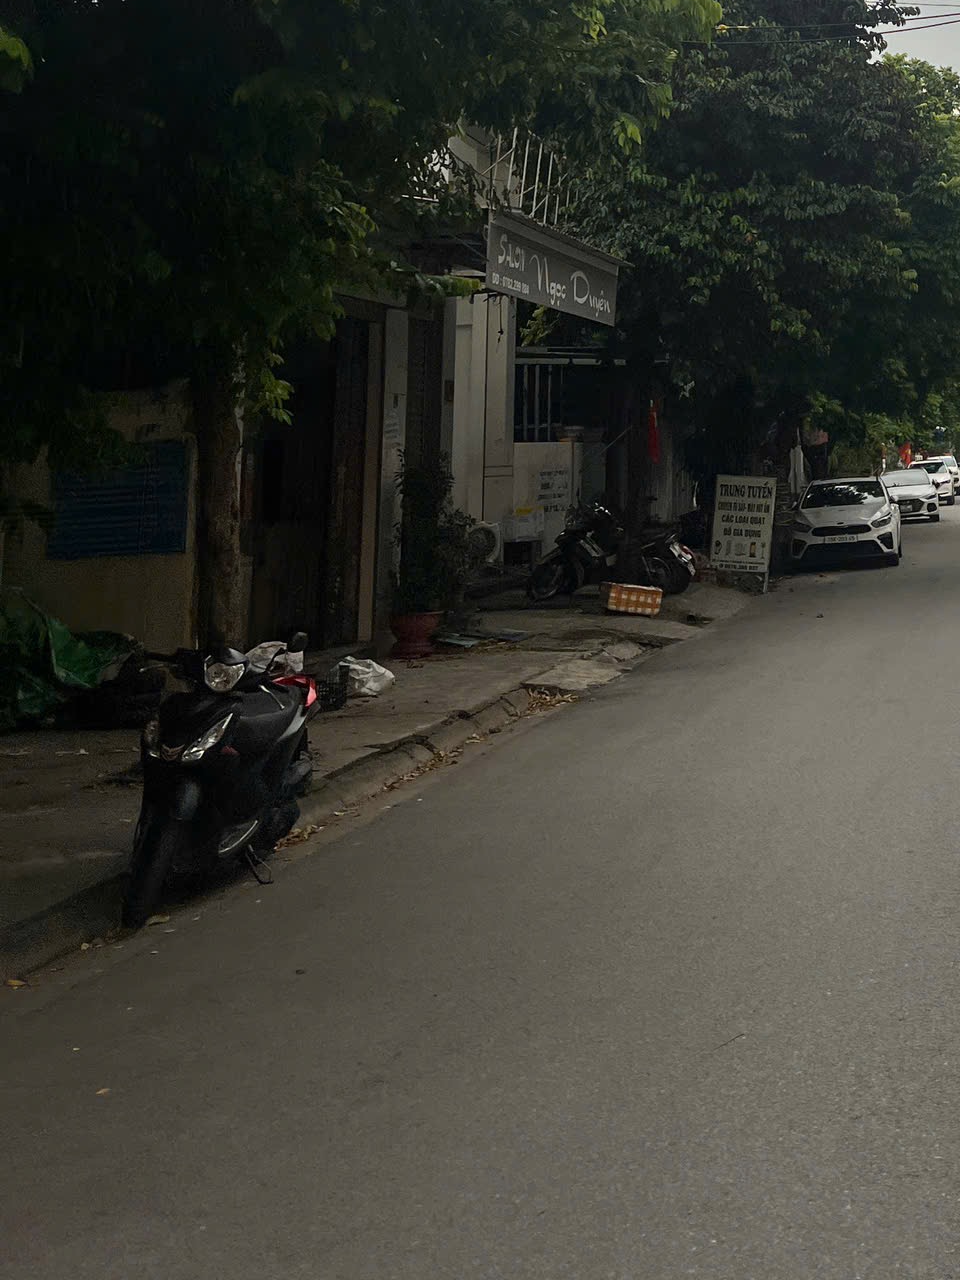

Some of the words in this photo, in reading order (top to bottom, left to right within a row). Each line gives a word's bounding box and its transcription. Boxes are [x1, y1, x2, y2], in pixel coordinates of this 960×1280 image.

[497, 234, 525, 272] SALON
[529, 254, 567, 307] Ngọc
[570, 271, 611, 317] Duyên
[720, 484, 745, 497] TRUNG
[733, 528, 743, 536] GIA
[744, 529, 761, 538] DỤNG
